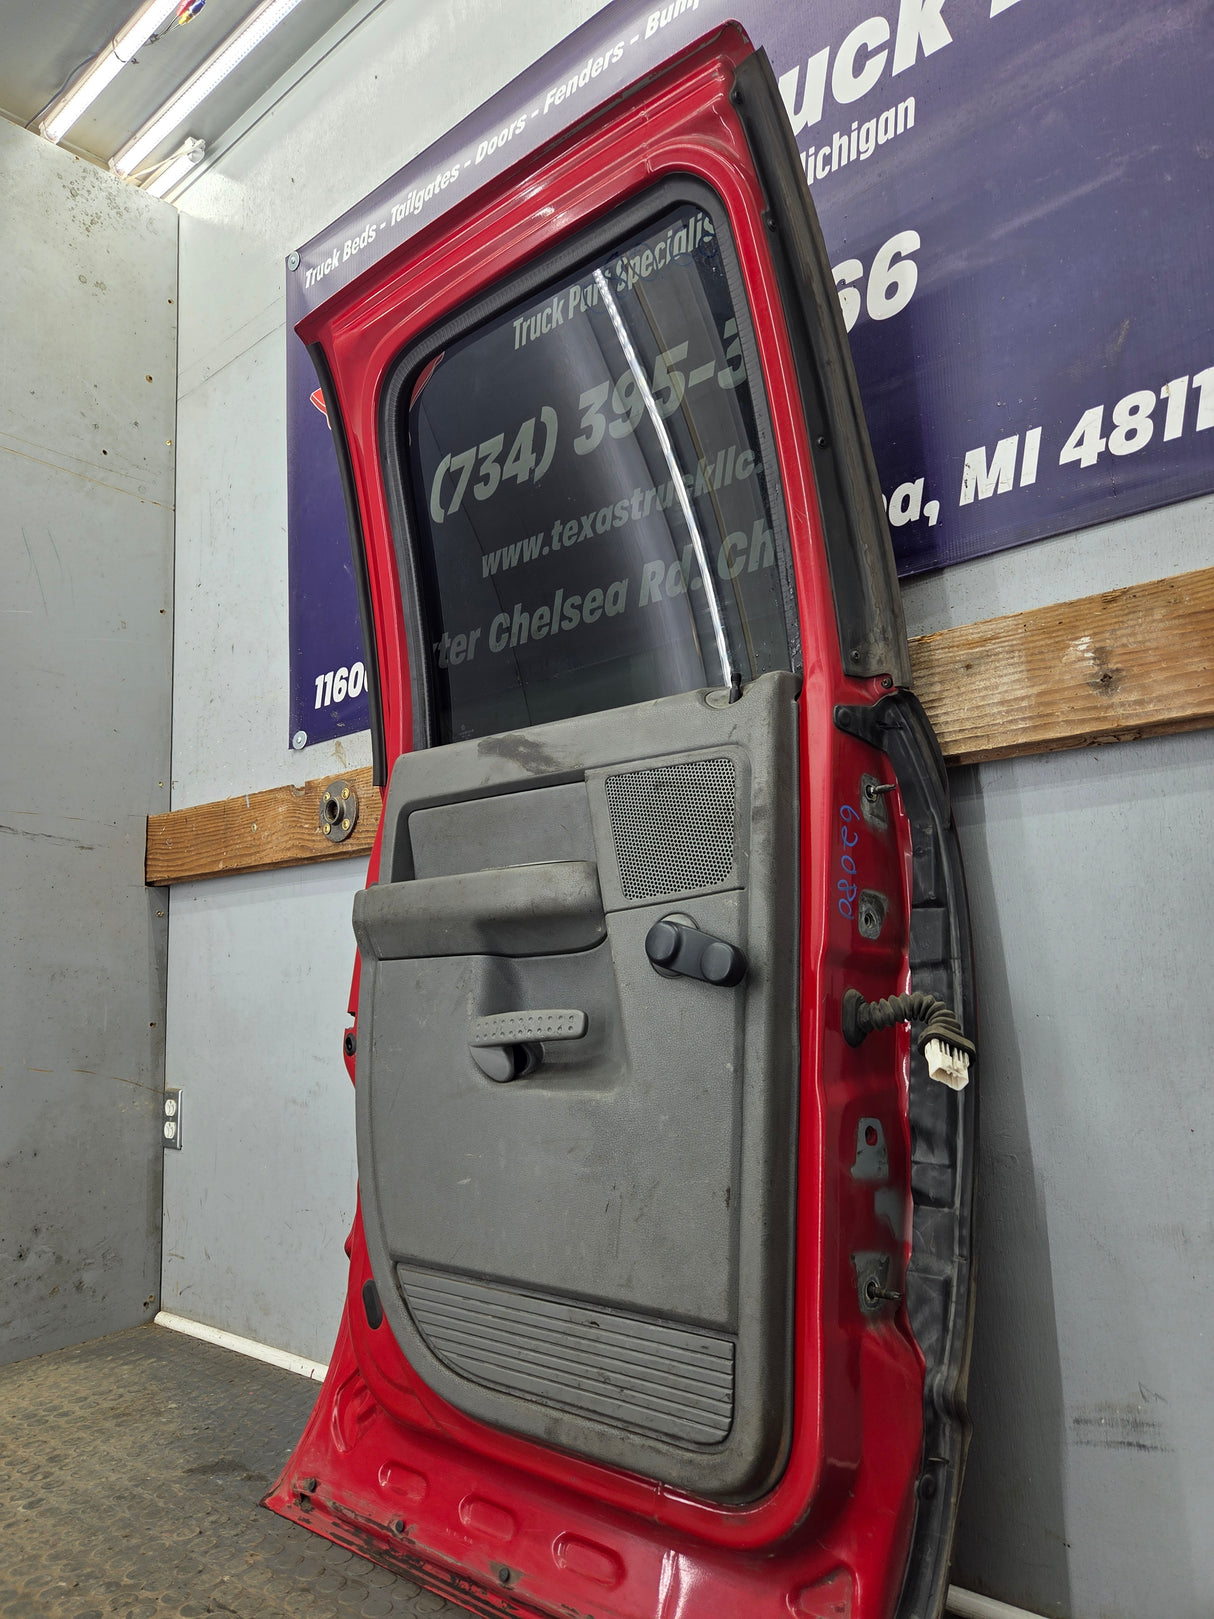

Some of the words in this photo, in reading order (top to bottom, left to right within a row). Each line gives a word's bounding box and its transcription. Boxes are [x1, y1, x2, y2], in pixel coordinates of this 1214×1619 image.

[305, 247, 341, 289] Truck
[342, 223, 377, 263] Beds
[390, 163, 461, 227] Tailgates
[475, 114, 527, 165] Doors
[543, 41, 625, 115] Fenders
[512, 296, 564, 350] Truck
[799, 96, 916, 186] ichigan
[314, 661, 369, 710] 1160
[488, 577, 629, 653] Chelsea
[638, 543, 703, 608] Rd.
[958, 426, 1043, 507] MI
[430, 405, 558, 524] (734)
